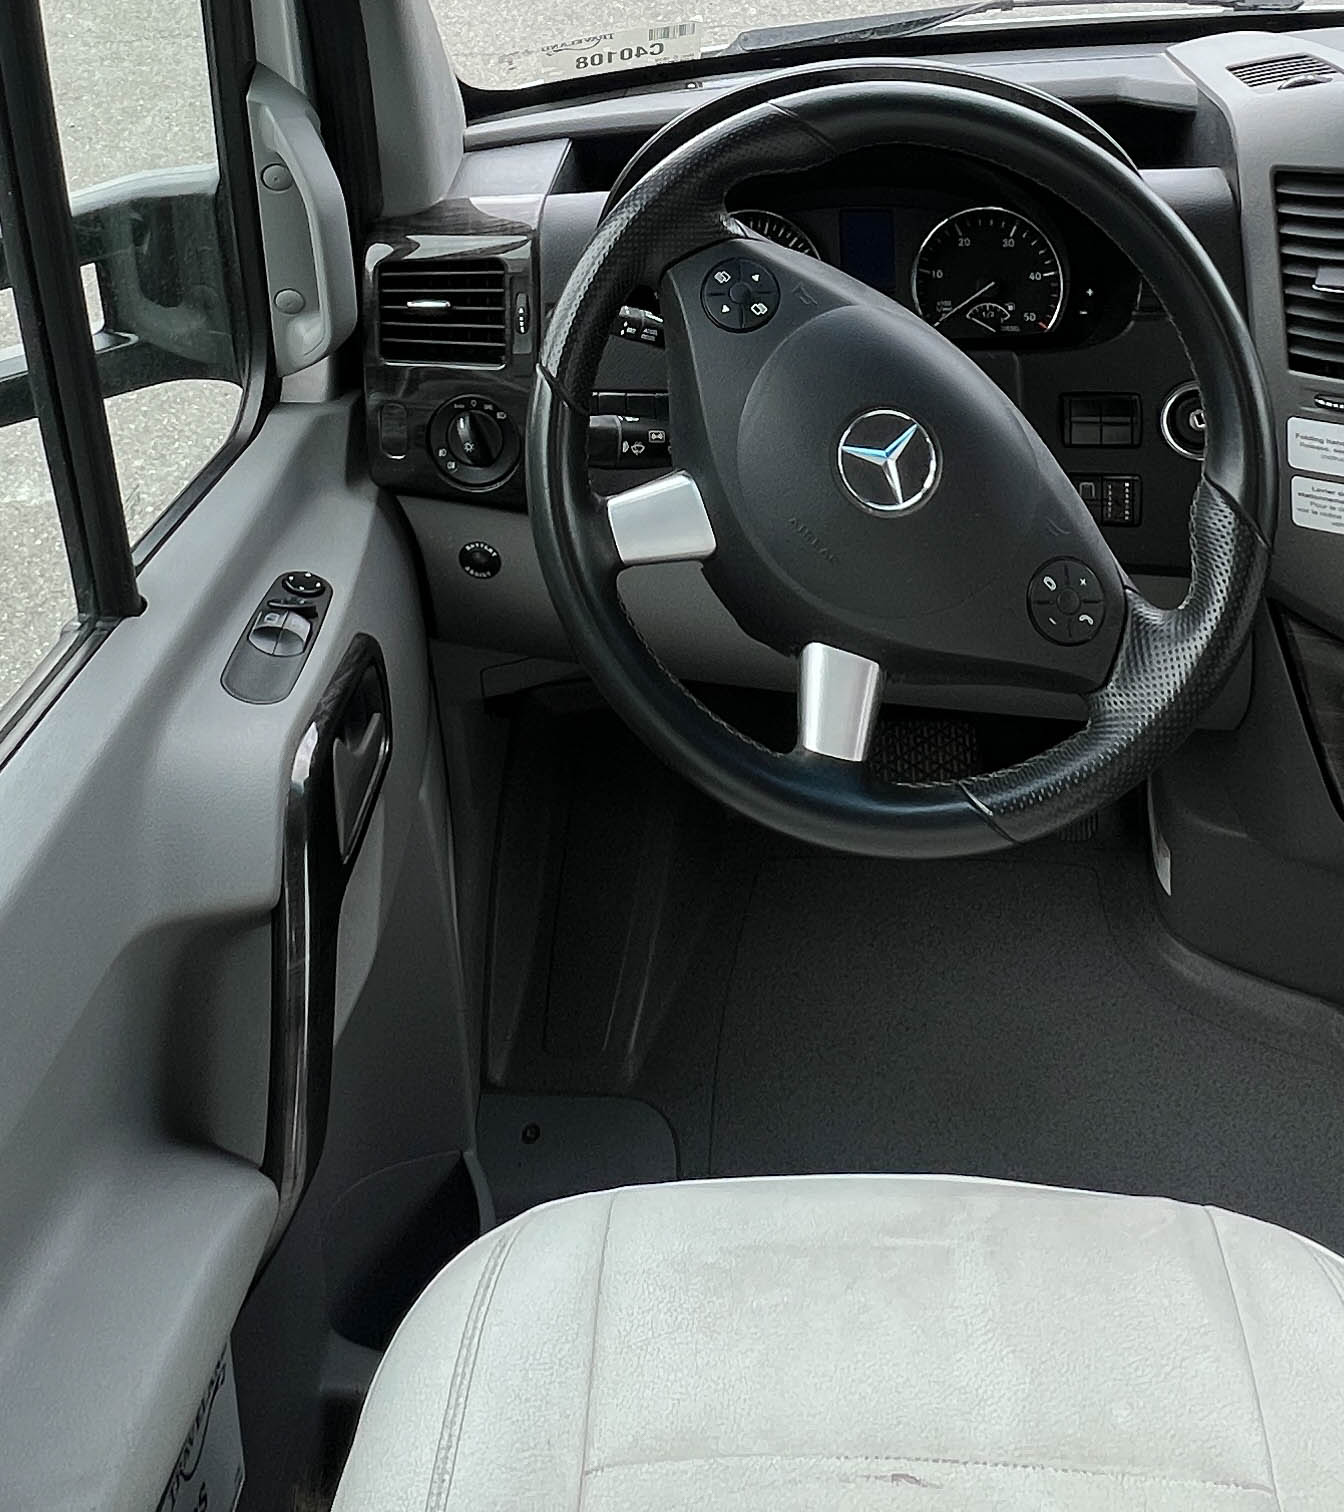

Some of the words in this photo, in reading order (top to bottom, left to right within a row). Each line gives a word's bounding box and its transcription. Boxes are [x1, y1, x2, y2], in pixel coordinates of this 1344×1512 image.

[958, 239, 971, 247] 20
[1002, 239, 1015, 248] 30
[932, 270, 943, 279] 10
[1029, 272, 1042, 281] 40
[1023, 313, 1036, 322] 50
